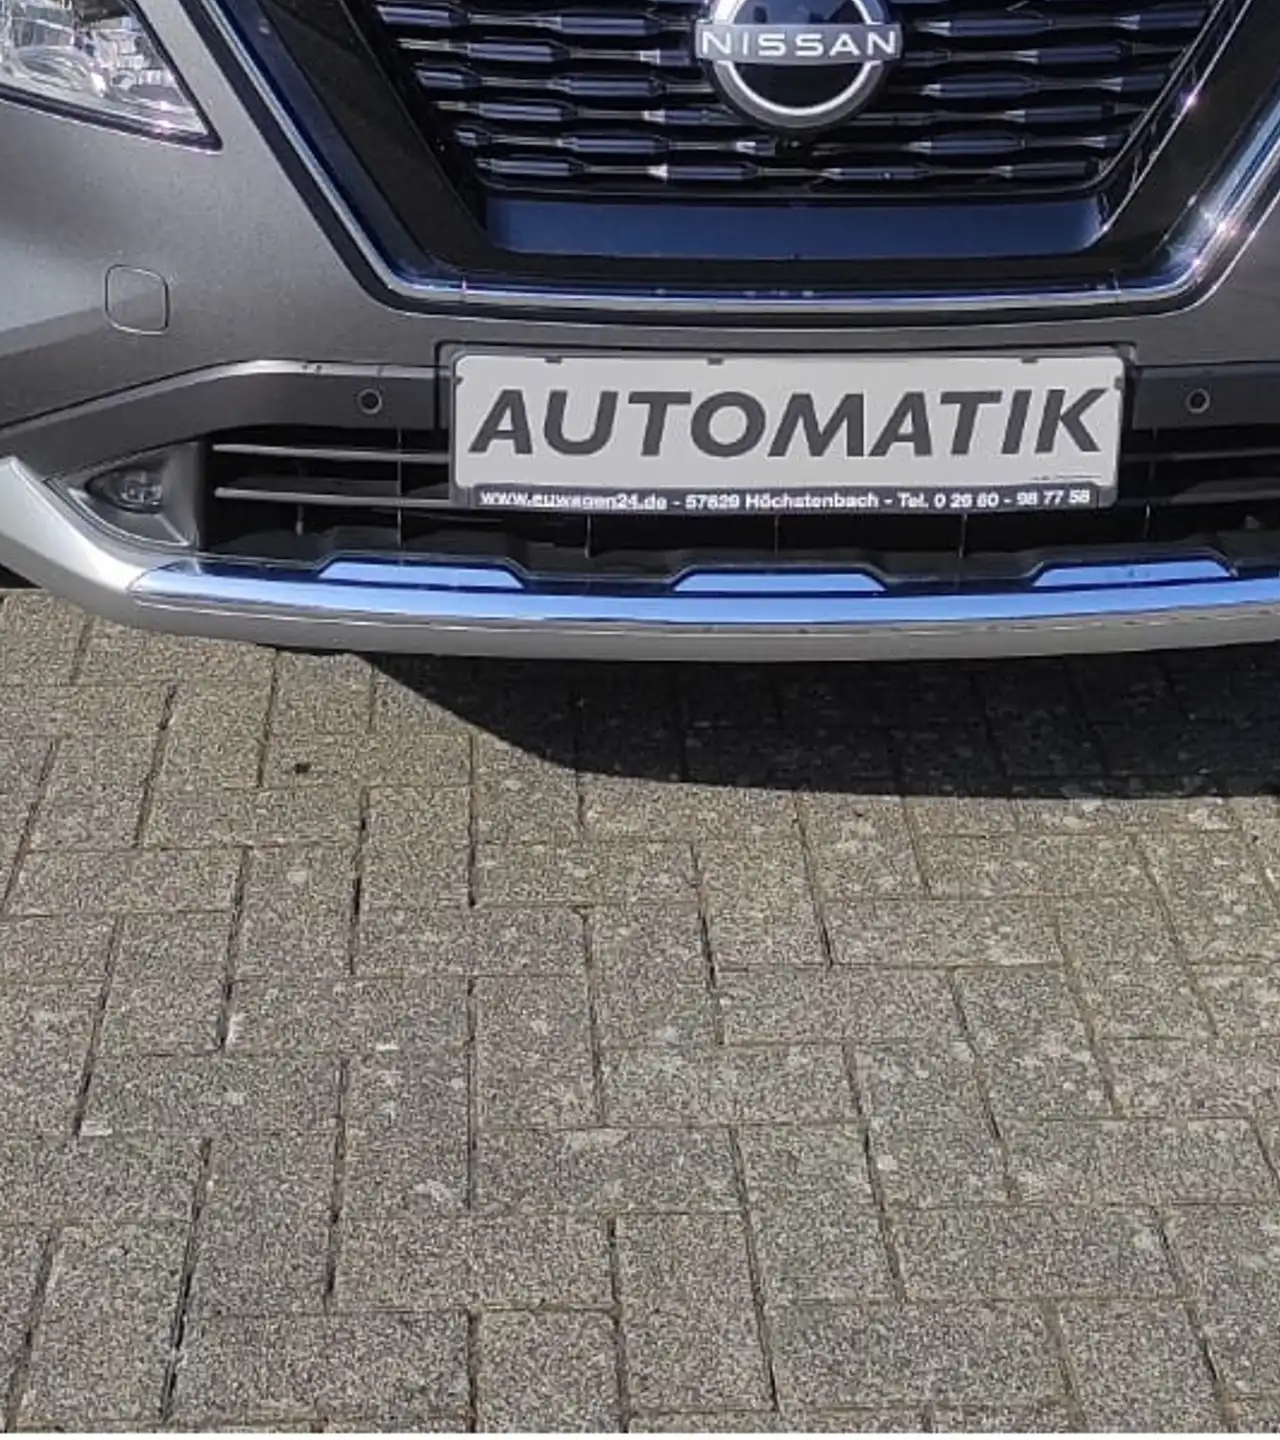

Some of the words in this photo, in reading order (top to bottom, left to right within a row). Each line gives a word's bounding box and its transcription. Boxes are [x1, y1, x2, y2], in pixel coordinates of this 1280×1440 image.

[702, 31, 895, 56] NISSAN
[469, 388, 1108, 458] AUTOMATIK
[480, 490, 667, 511] www.euwagen24.de
